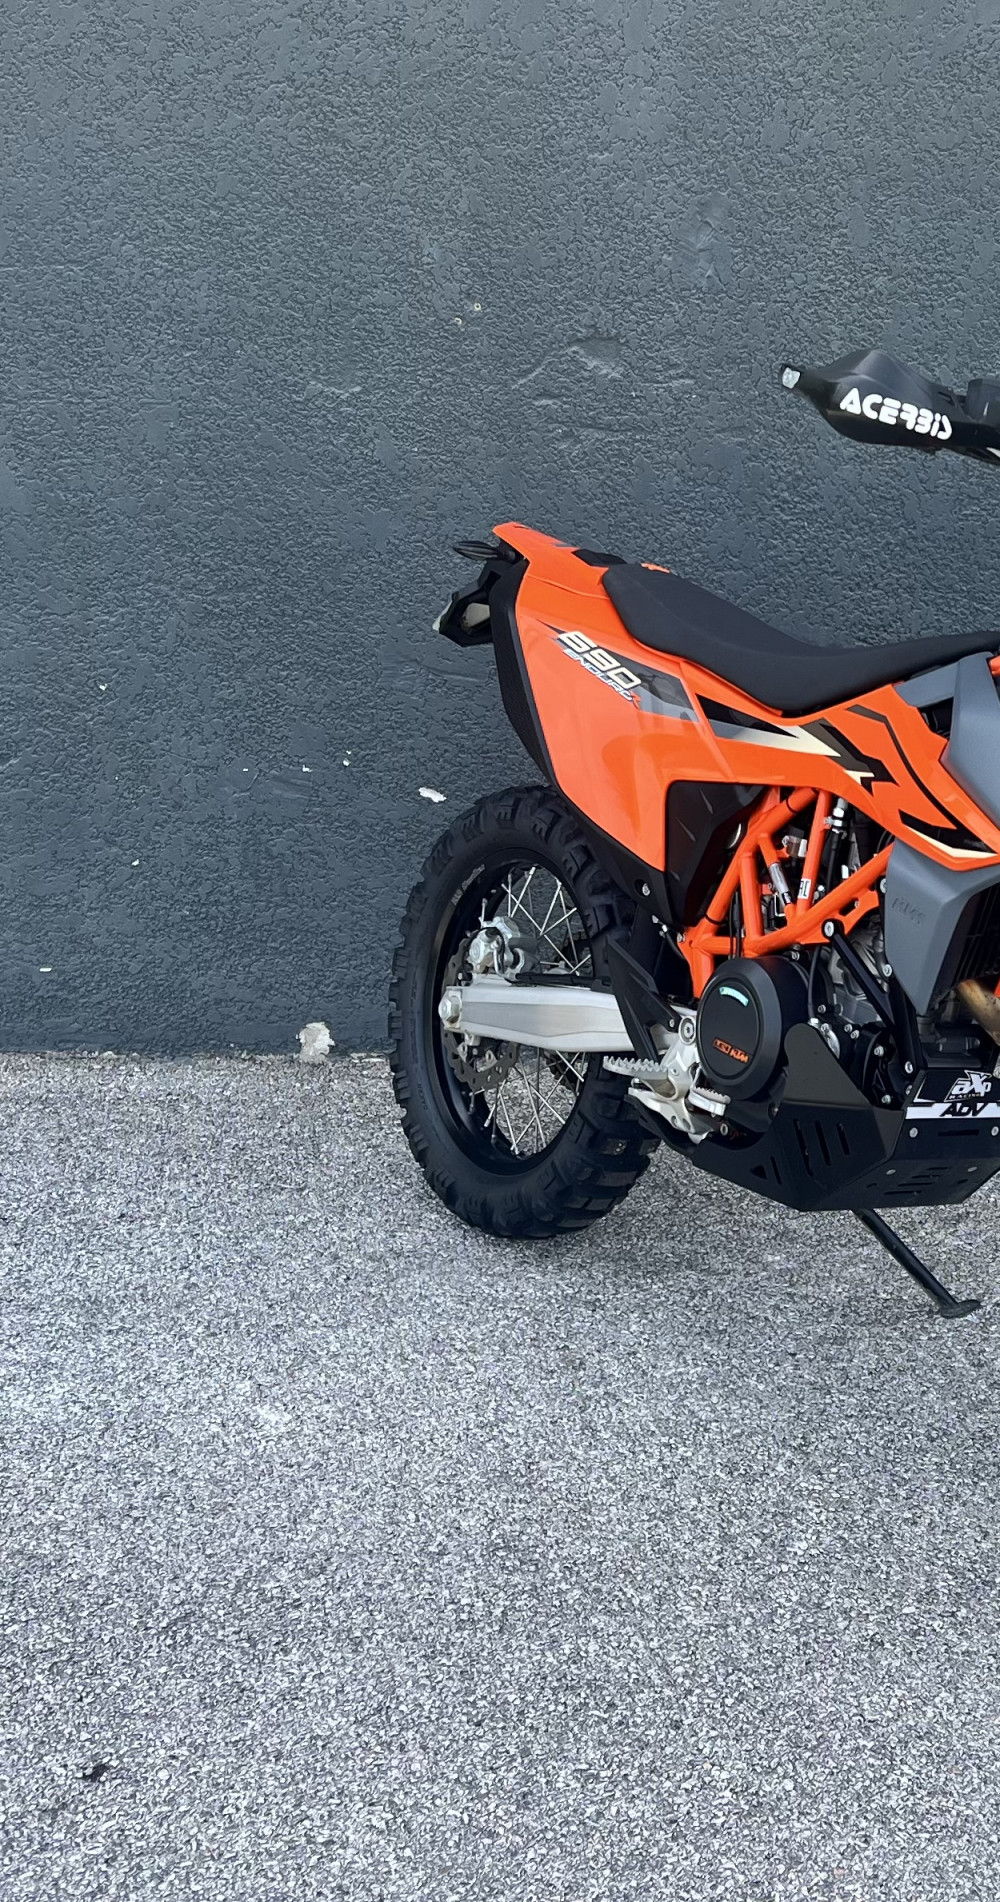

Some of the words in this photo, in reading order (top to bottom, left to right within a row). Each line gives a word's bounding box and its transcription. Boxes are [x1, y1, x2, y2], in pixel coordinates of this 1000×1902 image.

[839, 387, 953, 440] ACERBIS
[557, 630, 642, 690] 690
[562, 648, 634, 702] ENDURO
[939, 1102, 989, 1118] ADV
